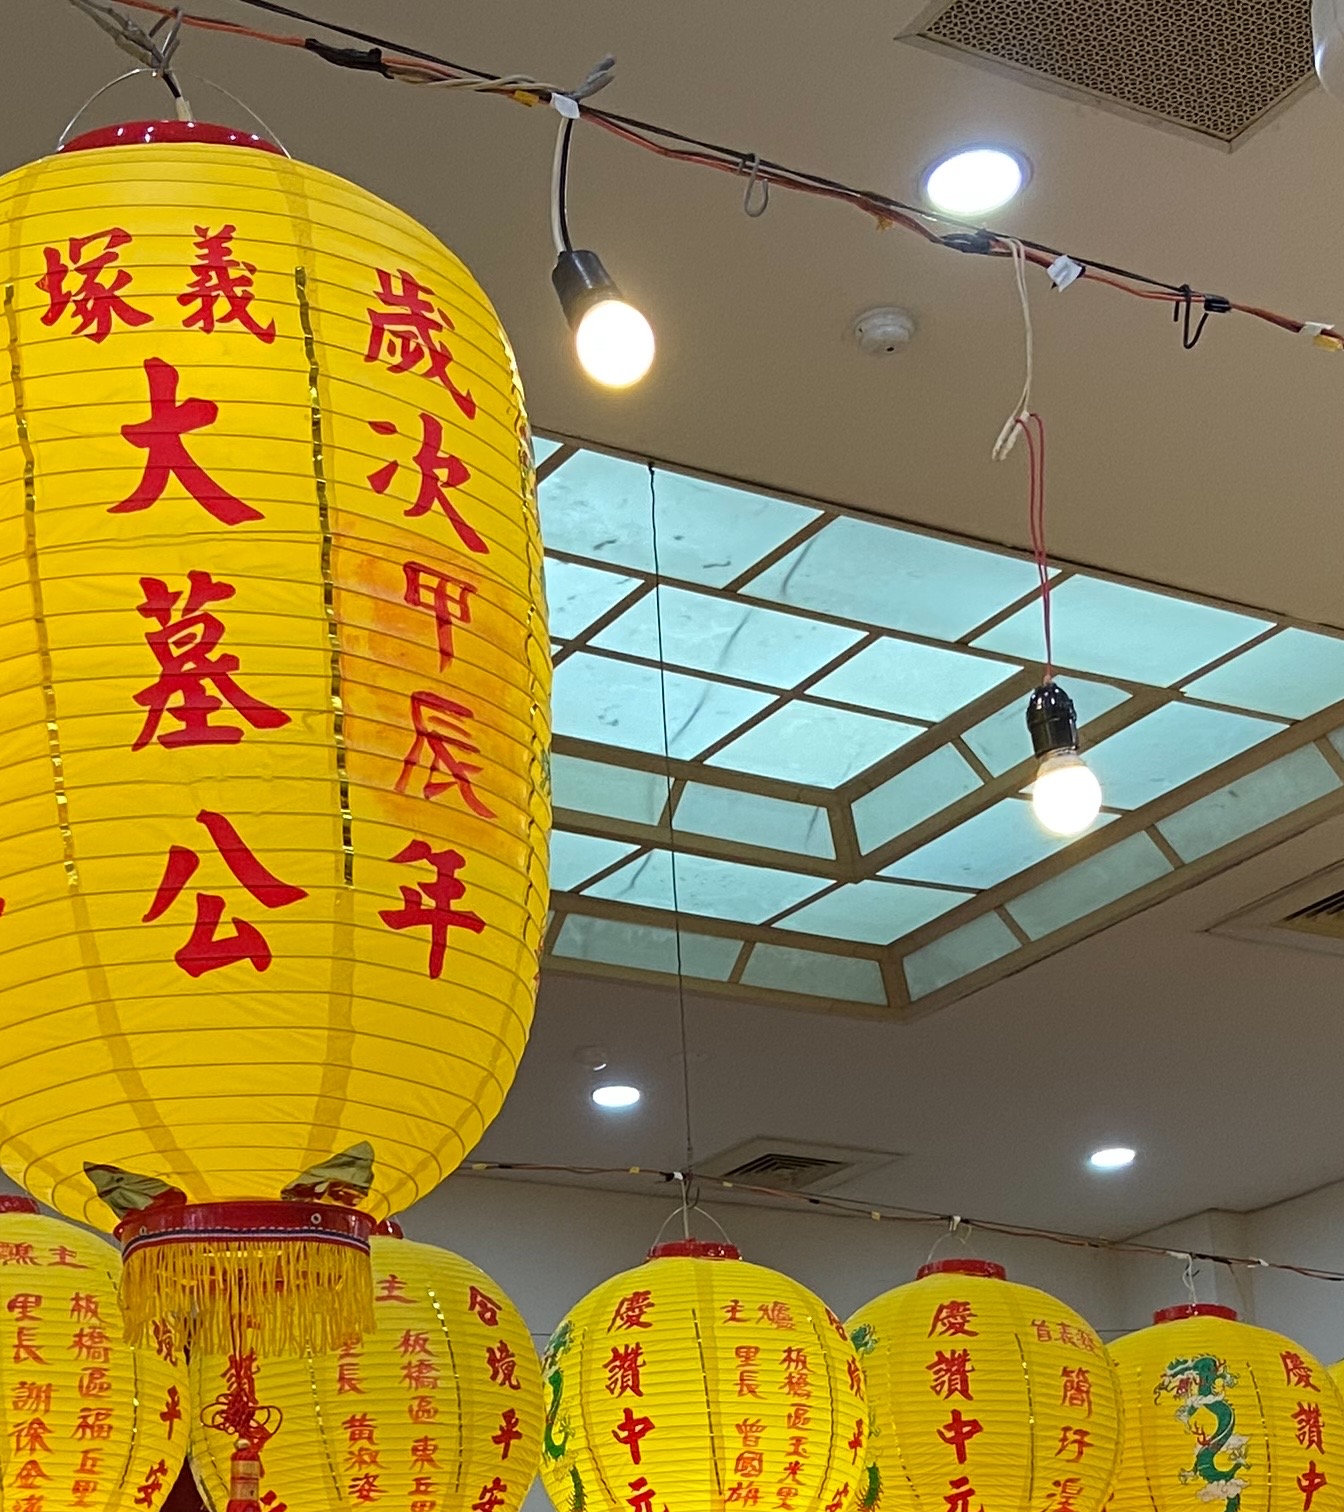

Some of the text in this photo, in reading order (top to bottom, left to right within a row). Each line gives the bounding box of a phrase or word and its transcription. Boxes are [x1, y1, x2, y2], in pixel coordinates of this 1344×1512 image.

[107, 358, 309, 978] 大墓公
[363, 266, 496, 979] 歲次甲辰年
[66, 1291, 115, 1508] 板橋區福丘里
[134, 1317, 184, 1510] 境平安
